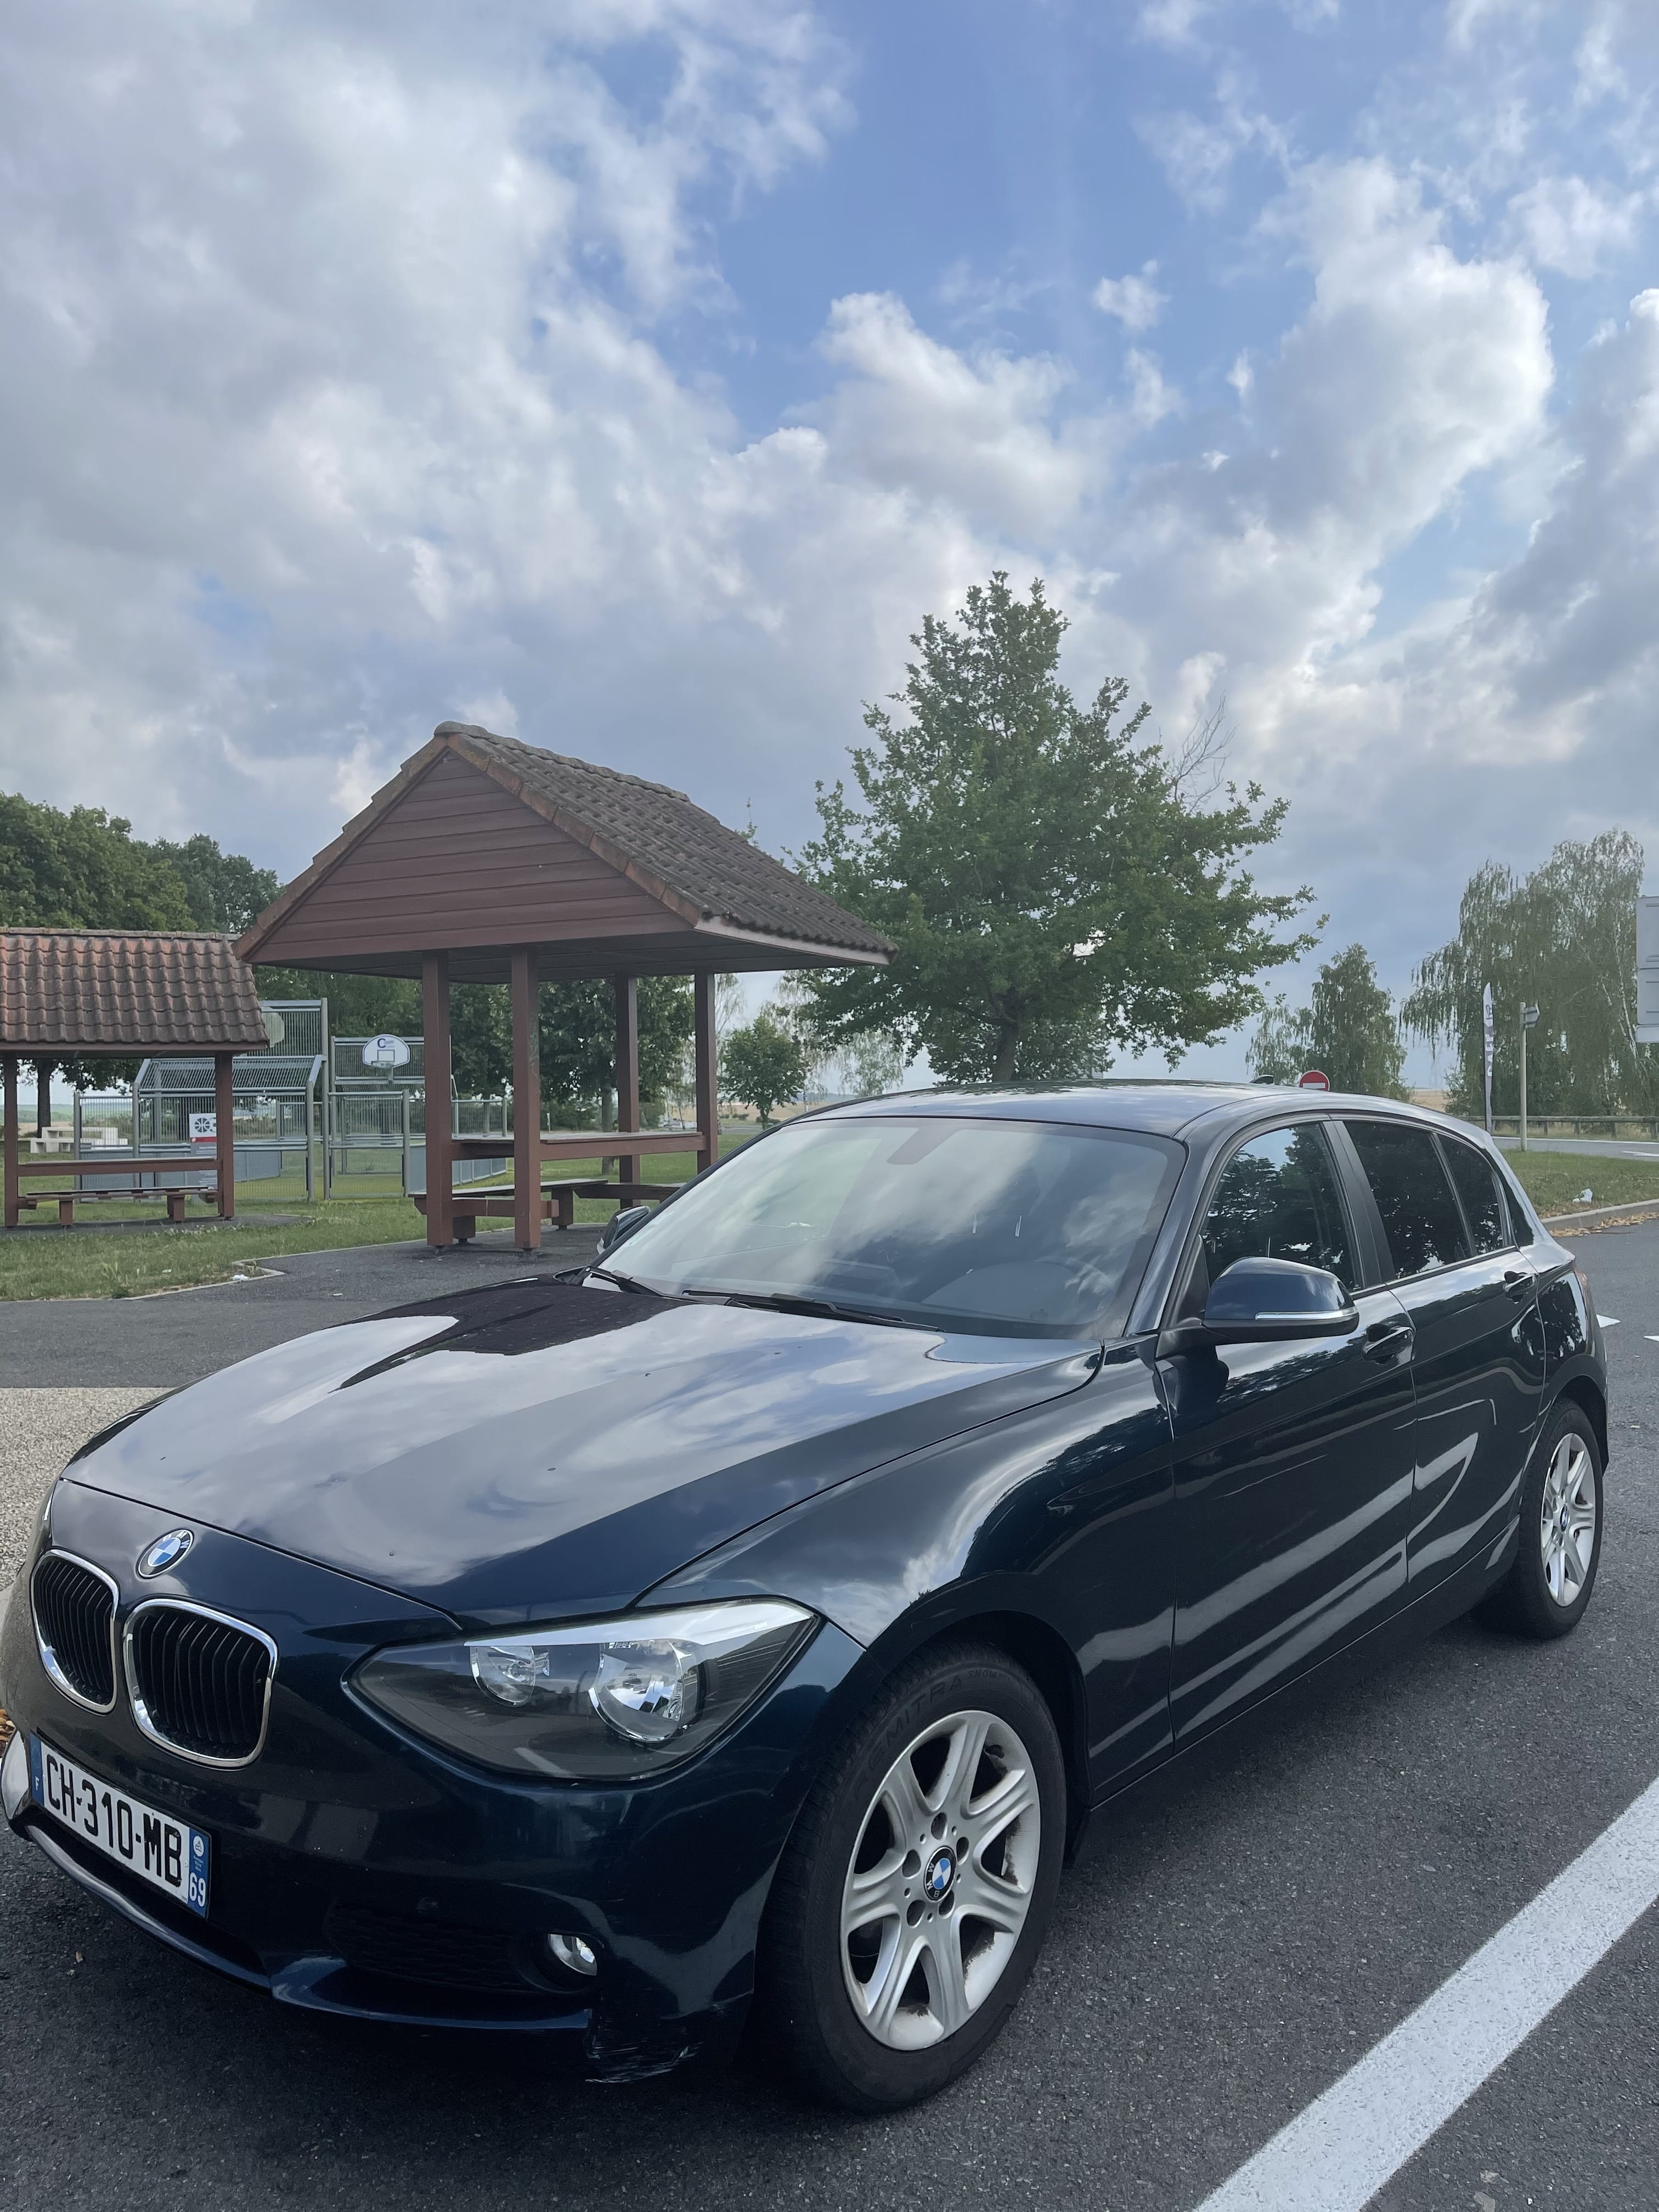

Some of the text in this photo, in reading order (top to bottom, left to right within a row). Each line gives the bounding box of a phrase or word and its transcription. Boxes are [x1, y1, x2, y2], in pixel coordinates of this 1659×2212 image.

[162, 1531, 190, 1549] BMW
[35, 1776, 40, 1791] F
[47, 1754, 182, 1887] CH-310-MB
[189, 1872, 206, 1907] 69
[926, 1863, 940, 1898] BMW
